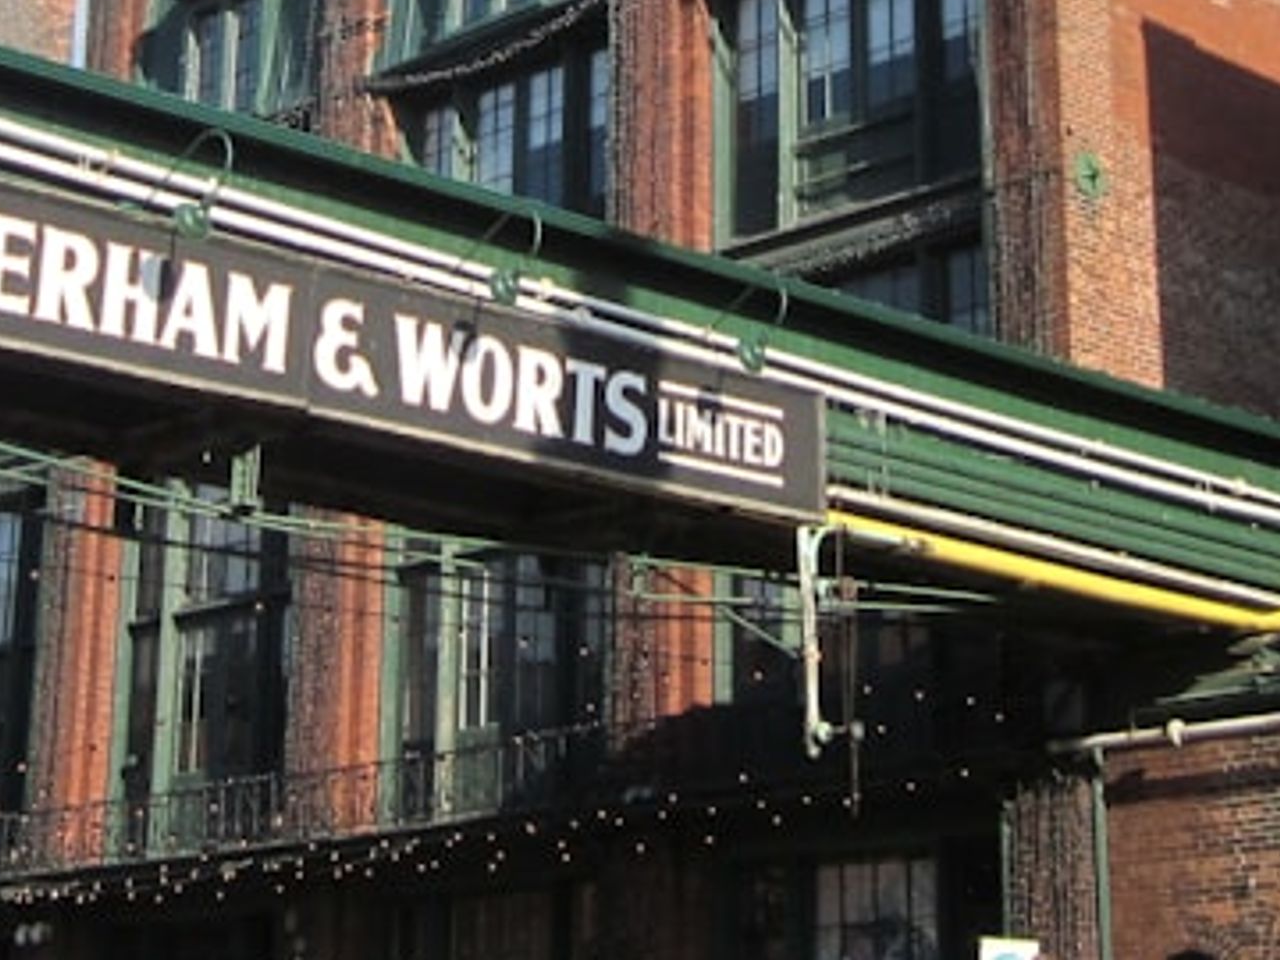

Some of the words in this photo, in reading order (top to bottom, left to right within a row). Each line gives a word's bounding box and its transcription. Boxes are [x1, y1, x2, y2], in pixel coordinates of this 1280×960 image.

[314, 298, 379, 398] &
[394, 312, 648, 457] WORTS
[657, 396, 784, 468] LIMITED
